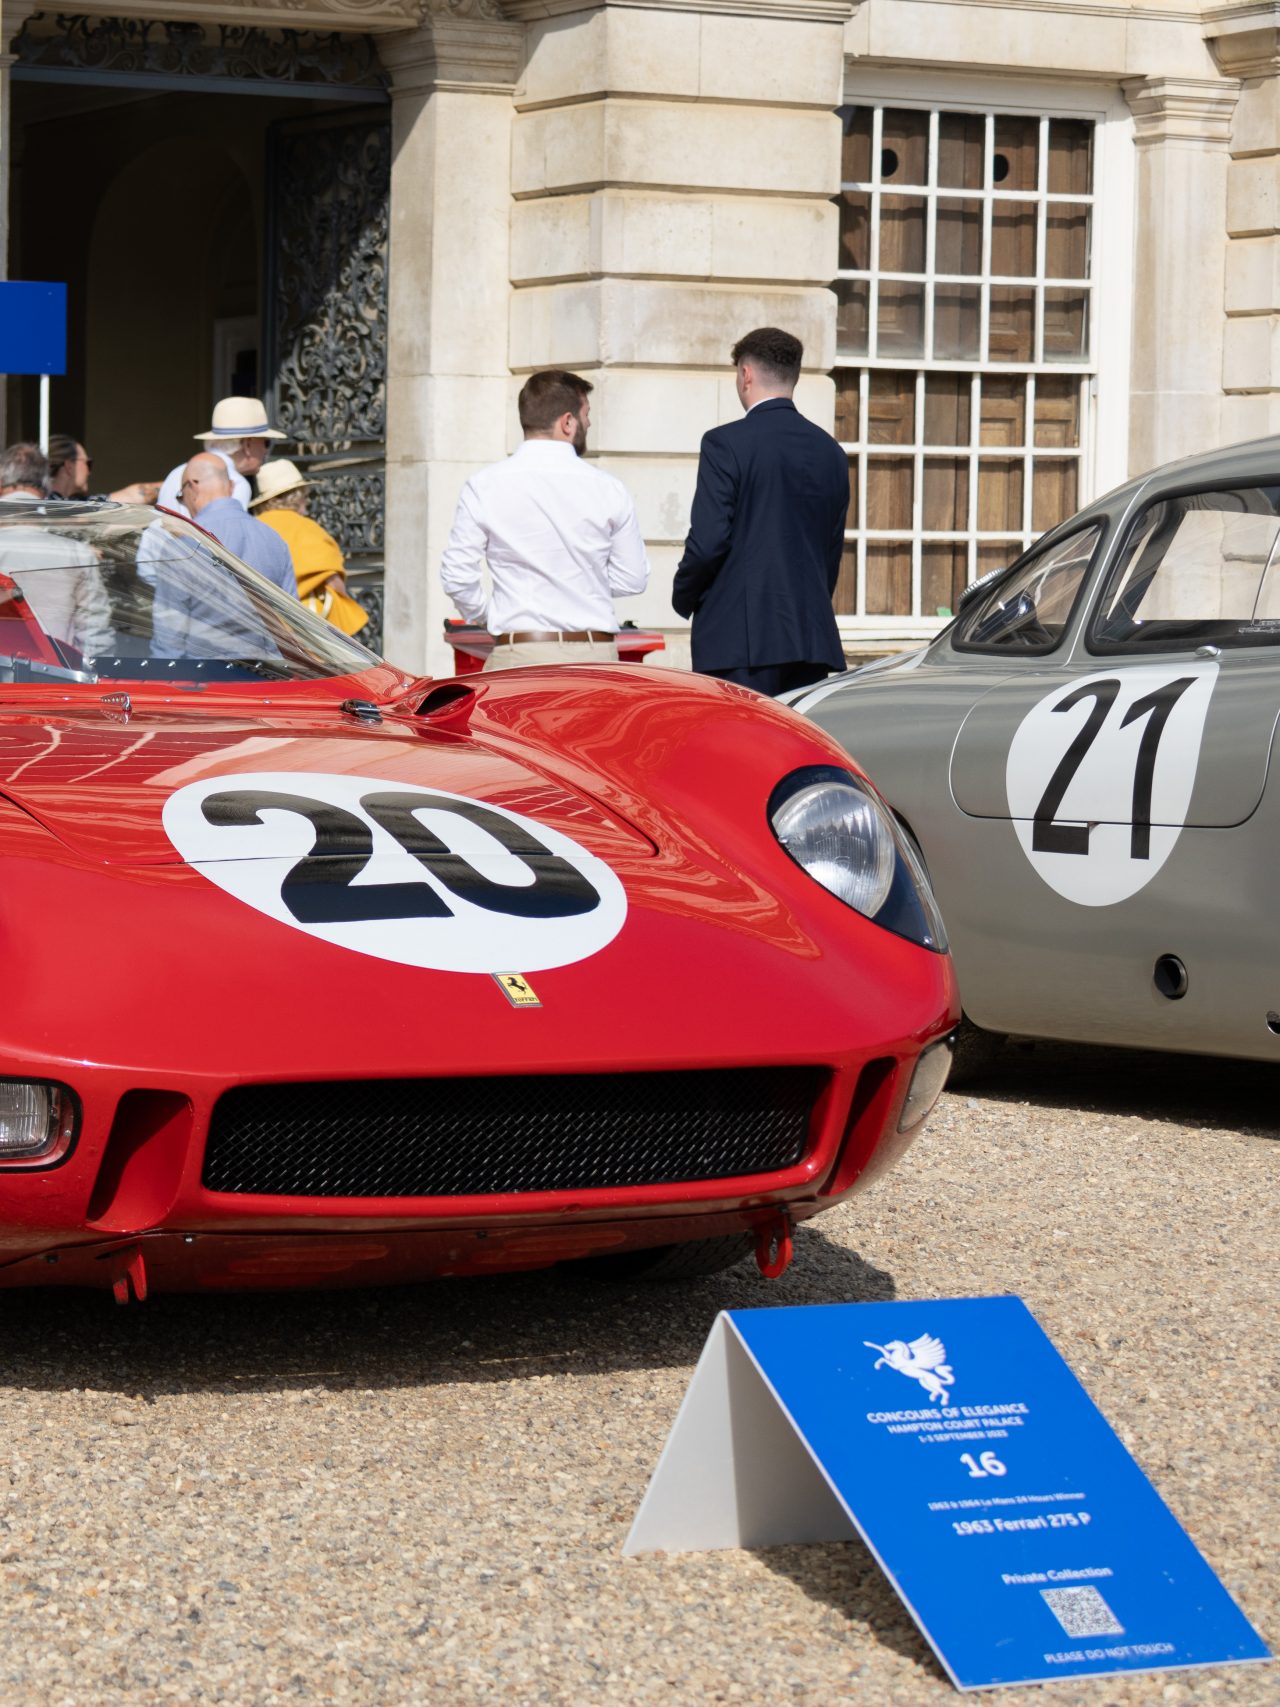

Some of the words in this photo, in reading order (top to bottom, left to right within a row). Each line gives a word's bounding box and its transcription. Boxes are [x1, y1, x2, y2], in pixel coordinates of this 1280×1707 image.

[1032, 676, 1199, 860] 21
[201, 790, 601, 923] 20
[866, 1408, 942, 1424] CONCOURS
[941, 1407, 960, 1418] OF
[960, 1402, 1029, 1417] ELEGANCE
[886, 1421, 943, 1434] HAMPTON
[942, 1418, 981, 1430] COURT
[981, 1416, 1024, 1427] PALACE
[933, 1430, 986, 1442] SEPTEMBER
[959, 1451, 1007, 1478] 16
[952, 1519, 995, 1536] 1963
[993, 1515, 1048, 1532] Ferrari
[1046, 1512, 1081, 1528] 275
[1077, 1511, 1092, 1525] P
[1001, 1571, 1047, 1585] Private
[1046, 1566, 1113, 1581] Collection
[1043, 1651, 1085, 1664] PLEASE
[1085, 1649, 1104, 1660] DO
[1104, 1646, 1132, 1659] NOT
[1131, 1642, 1175, 1655] TOUCH
